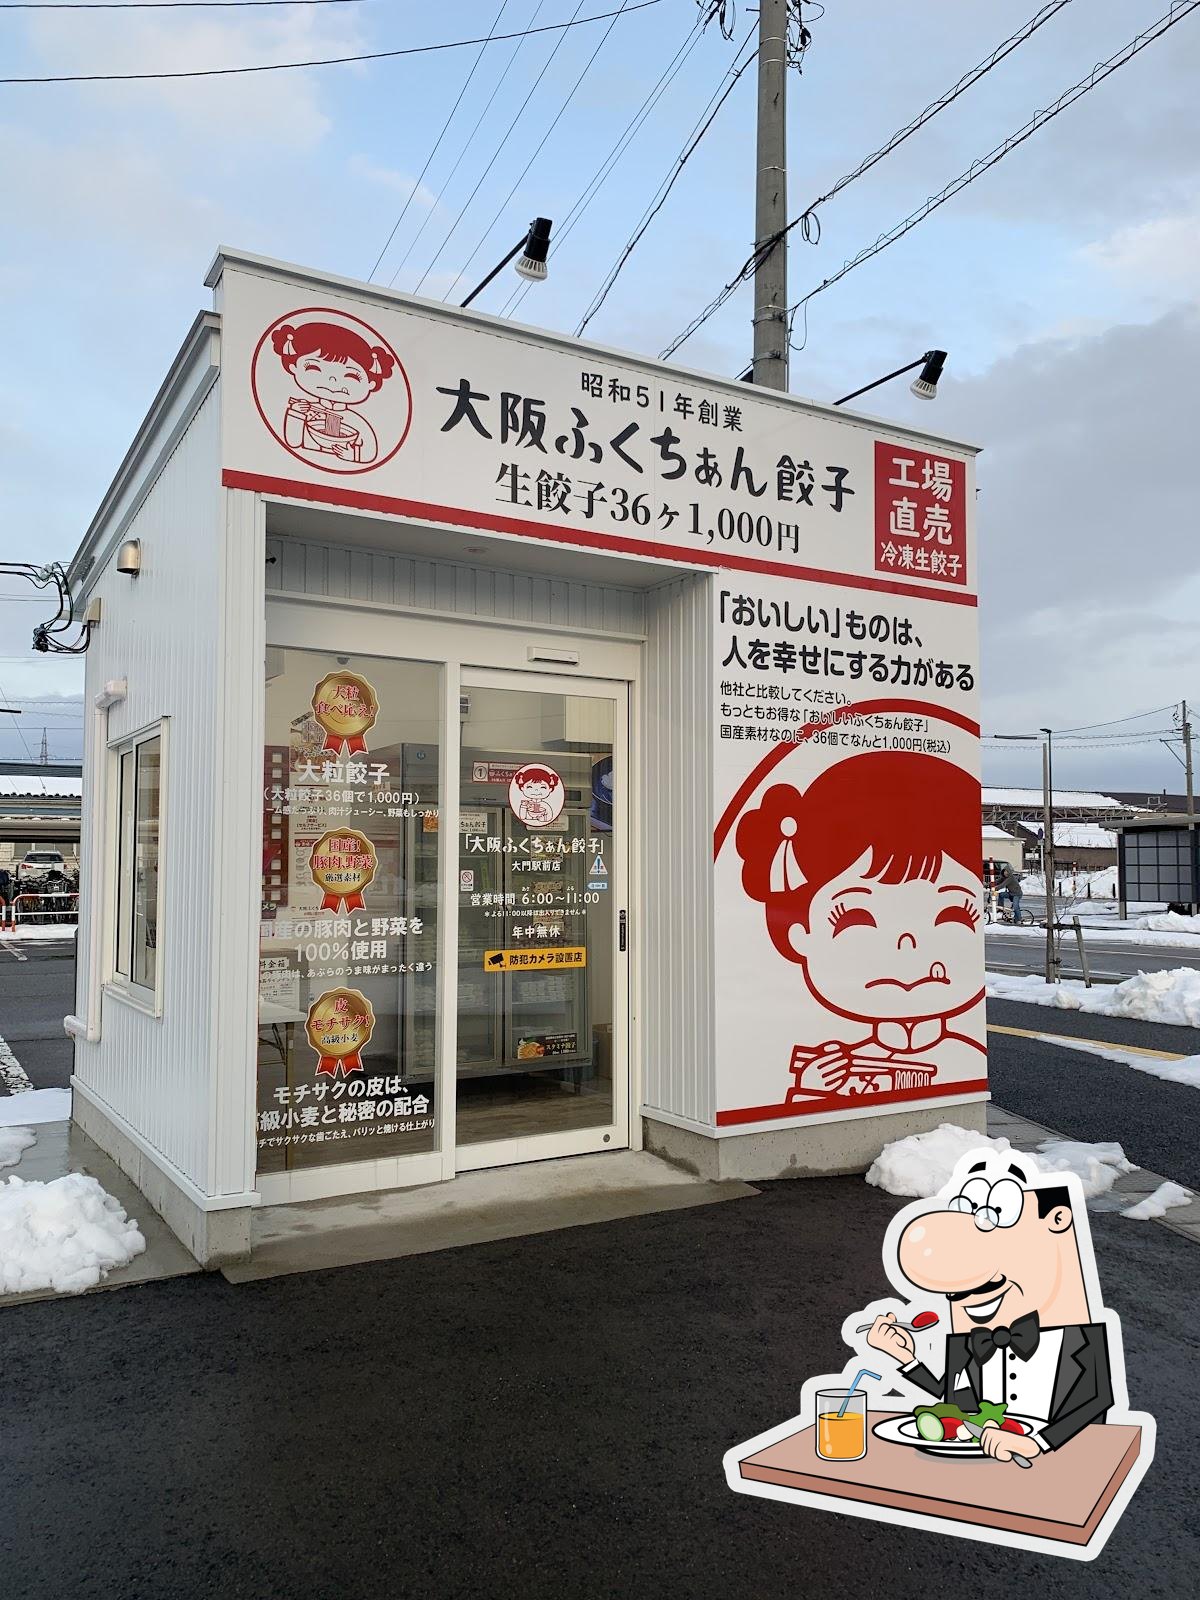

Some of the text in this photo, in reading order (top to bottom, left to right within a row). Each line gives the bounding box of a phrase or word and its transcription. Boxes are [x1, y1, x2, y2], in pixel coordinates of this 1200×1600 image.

[581, 371, 743, 432] 昭和51年創業
[435, 378, 855, 513] 大阪ふくちぁん餃子
[888, 457, 954, 502] 工場
[888, 496, 953, 546] 直売
[880, 541, 963, 578] 冷凍生餃子
[719, 590, 923, 648] 「おいしい」ものは、
[722, 635, 975, 692] 人を幸せにする力がある
[720, 680, 852, 706] 他社と比較してください。
[298, 759, 390, 785] 大粒餃子
[465, 833, 604, 855] 「大阪ふくちぁん餃子」
[511, 860, 562, 872] 大門駅前店
[470, 893, 516, 906] 営業時間
[511, 924, 562, 939] 年中無休
[295, 940, 387, 962] 100%使用
[509, 951, 583, 966] 防犯カメラ設置店
[273, 1074, 409, 1105] モチサクの皮は、
[256, 1094, 430, 1132] 級小麦と秘密の配合
